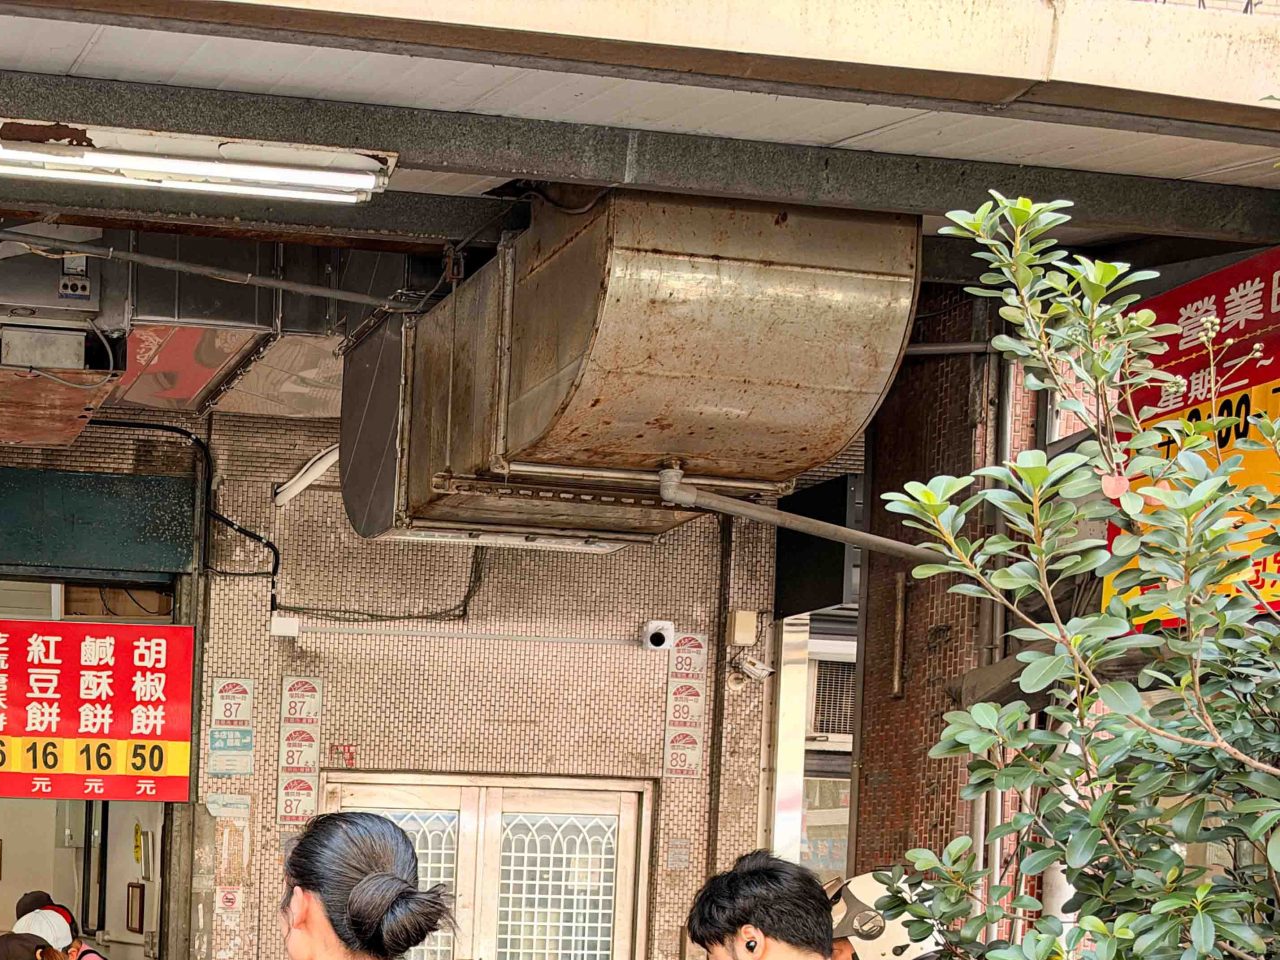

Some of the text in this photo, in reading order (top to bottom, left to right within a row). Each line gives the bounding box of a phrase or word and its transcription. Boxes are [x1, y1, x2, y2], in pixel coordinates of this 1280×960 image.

[675, 656, 692, 671] 89
[25, 633, 62, 733] 紅豆餅
[77, 635, 115, 734] 鹹酥餅
[130, 637, 167, 735] 胡椒餅
[223, 702, 241, 718] 87
[289, 701, 306, 716] 87
[673, 704, 689, 719] 89
[26, 741, 58, 770] 16
[79, 743, 112, 771] 16
[131, 744, 164, 772] 50
[286, 750, 303, 765] 87
[670, 752, 686, 767] 89
[31, 777, 52, 792] 元
[84, 778, 104, 794] 元
[136, 779, 156, 795] 元
[284, 799, 301, 814] 87
